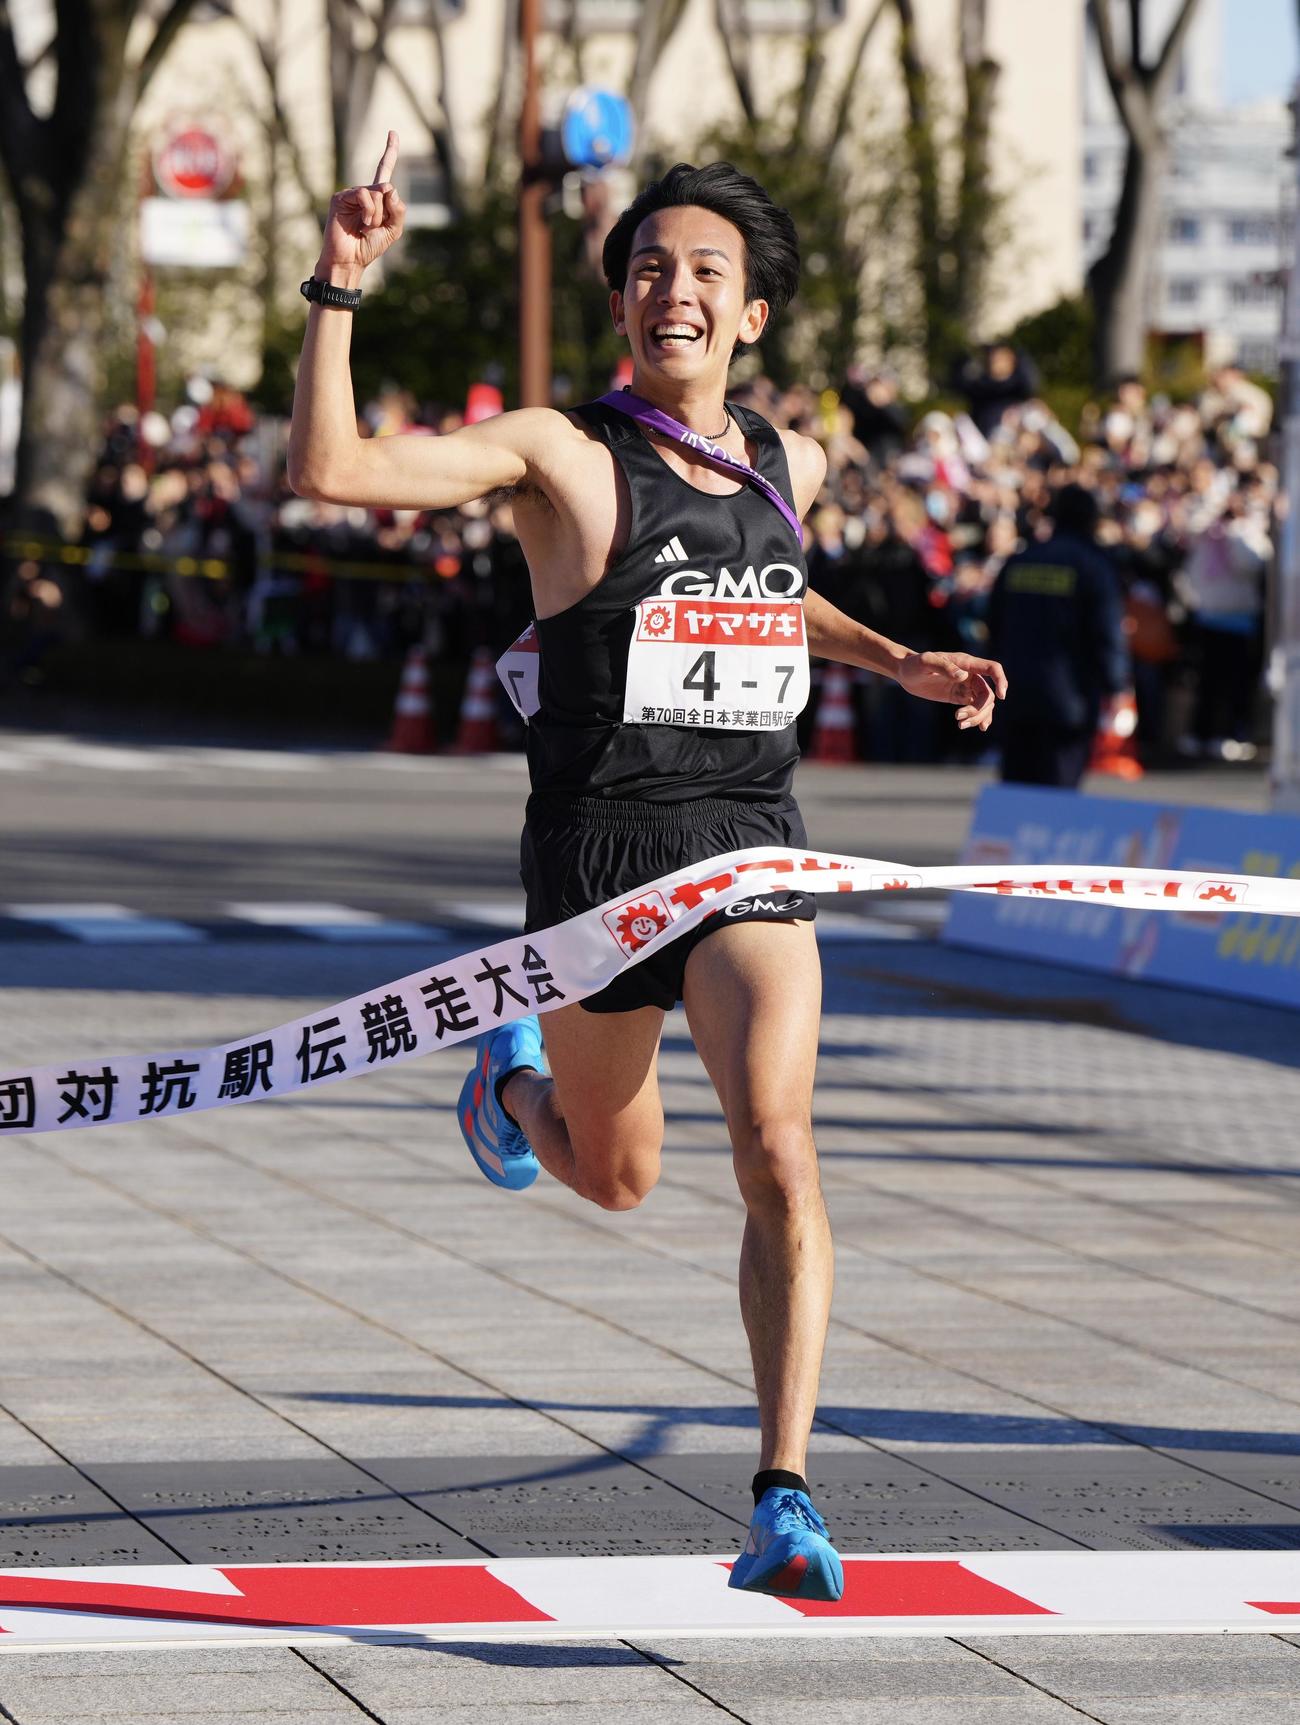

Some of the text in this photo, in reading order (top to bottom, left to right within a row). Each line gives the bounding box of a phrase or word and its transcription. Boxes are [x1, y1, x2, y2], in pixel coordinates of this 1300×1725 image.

[660, 563, 804, 599] GMO
[683, 609, 798, 638] ヤマザキ
[724, 898, 804, 917] GMO
